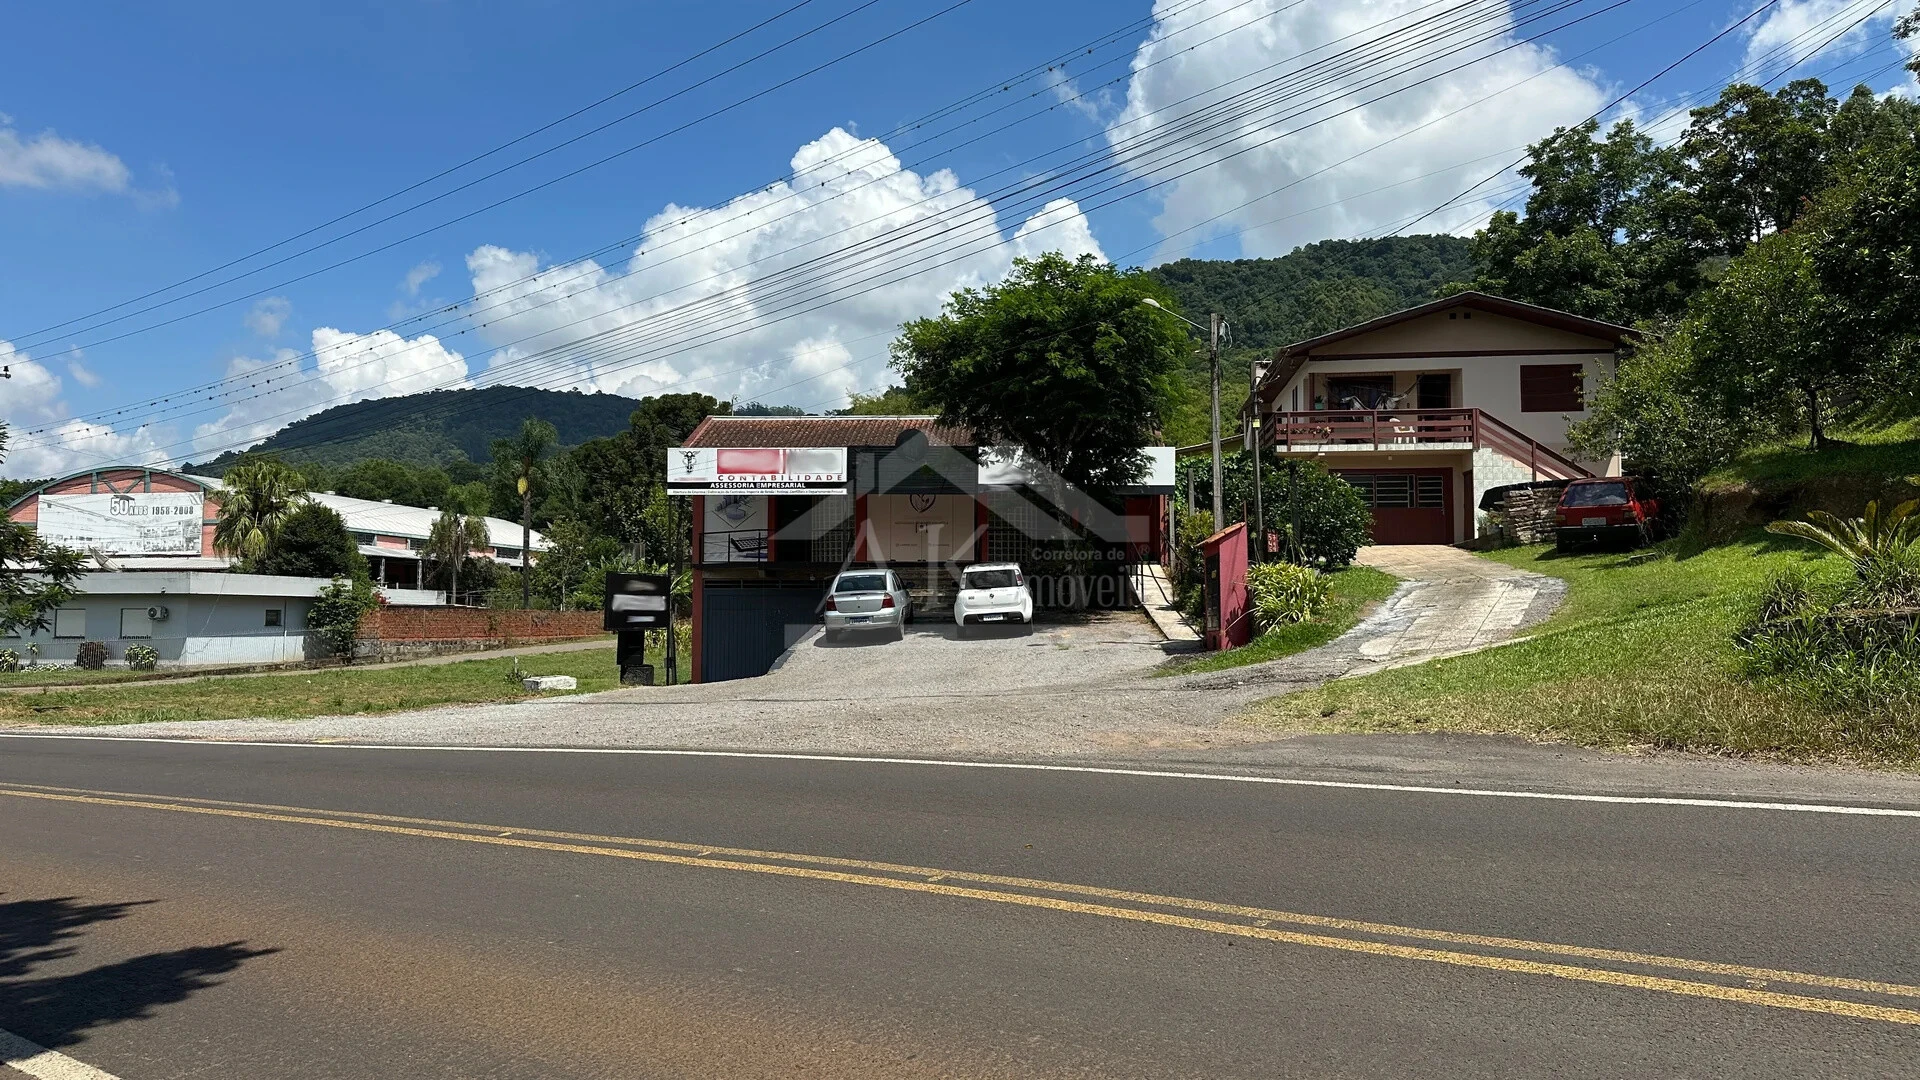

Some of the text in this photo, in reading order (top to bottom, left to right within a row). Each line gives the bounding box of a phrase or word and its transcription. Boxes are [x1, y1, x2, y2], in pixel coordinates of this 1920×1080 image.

[110, 497, 194, 516] 50 ANOS 1958-2008
